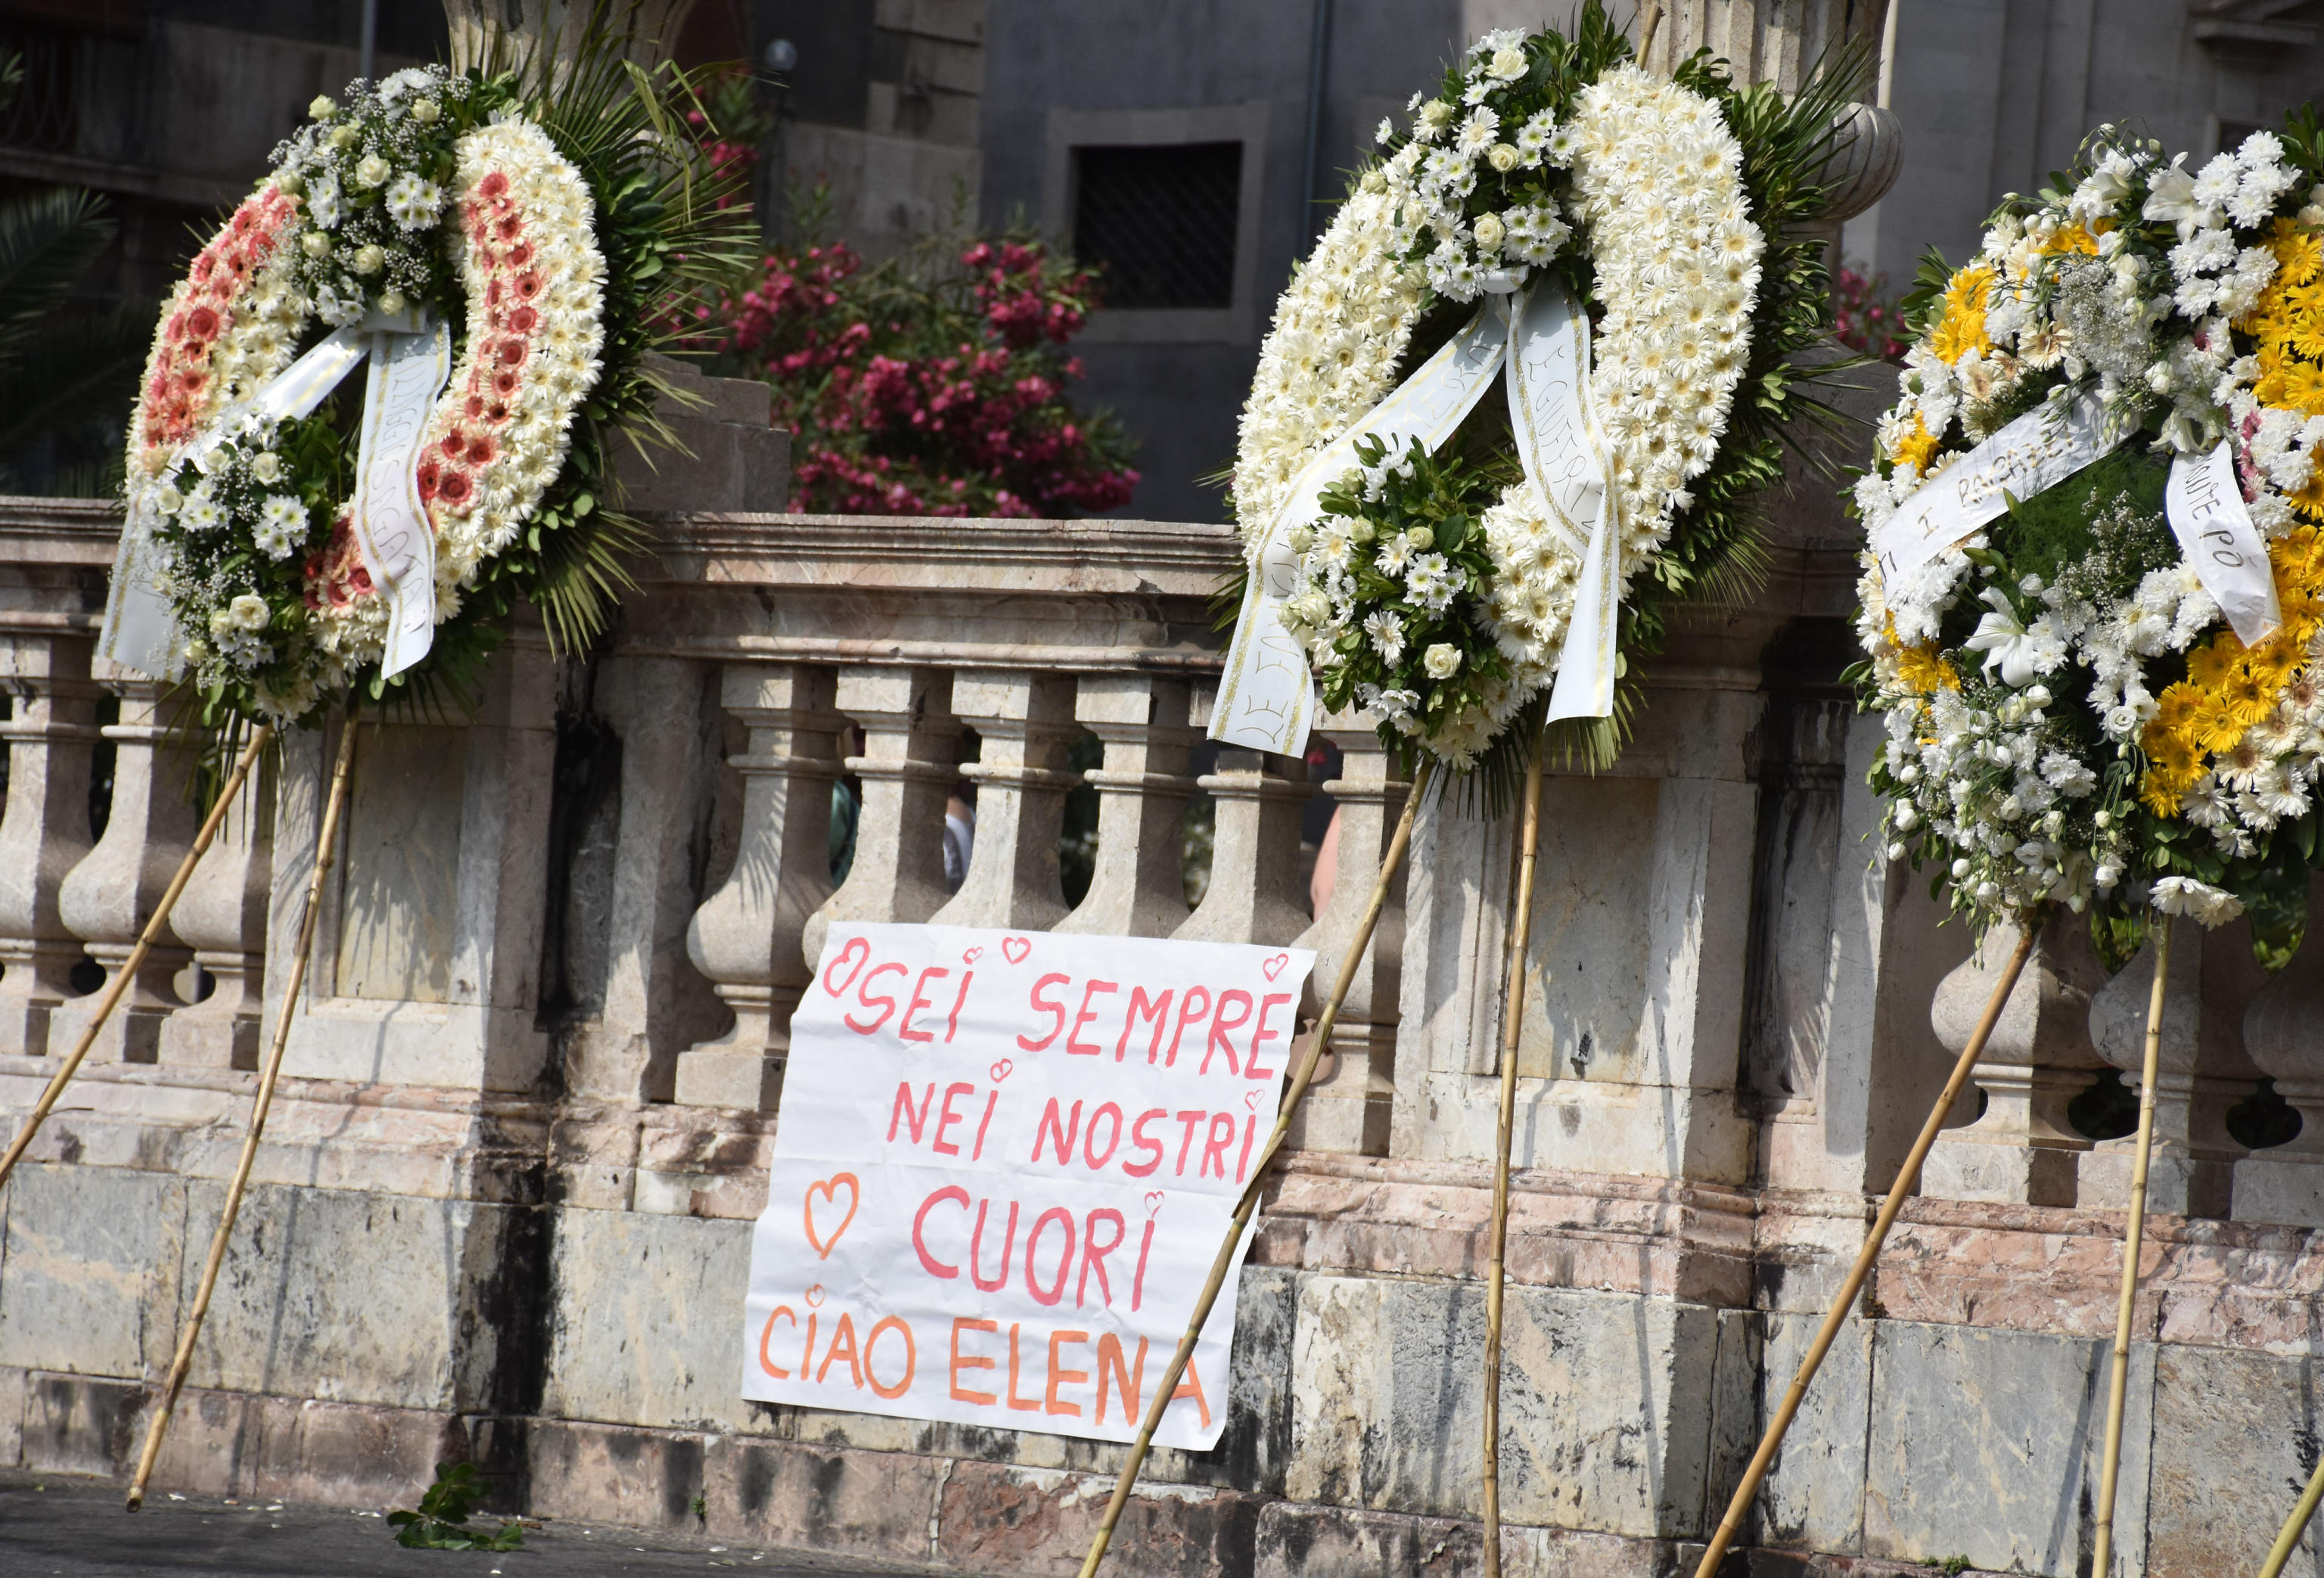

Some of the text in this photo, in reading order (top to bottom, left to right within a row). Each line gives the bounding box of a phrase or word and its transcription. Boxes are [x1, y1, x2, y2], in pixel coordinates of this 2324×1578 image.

[1918, 506, 1940, 540] I
[844, 961, 1292, 1081] SEI SEMPRE
[887, 1082, 1257, 1185] NEI NOSTRI
[912, 1185, 1156, 1312] CUORI
[759, 1305, 1212, 1430] CIAO ELENA
